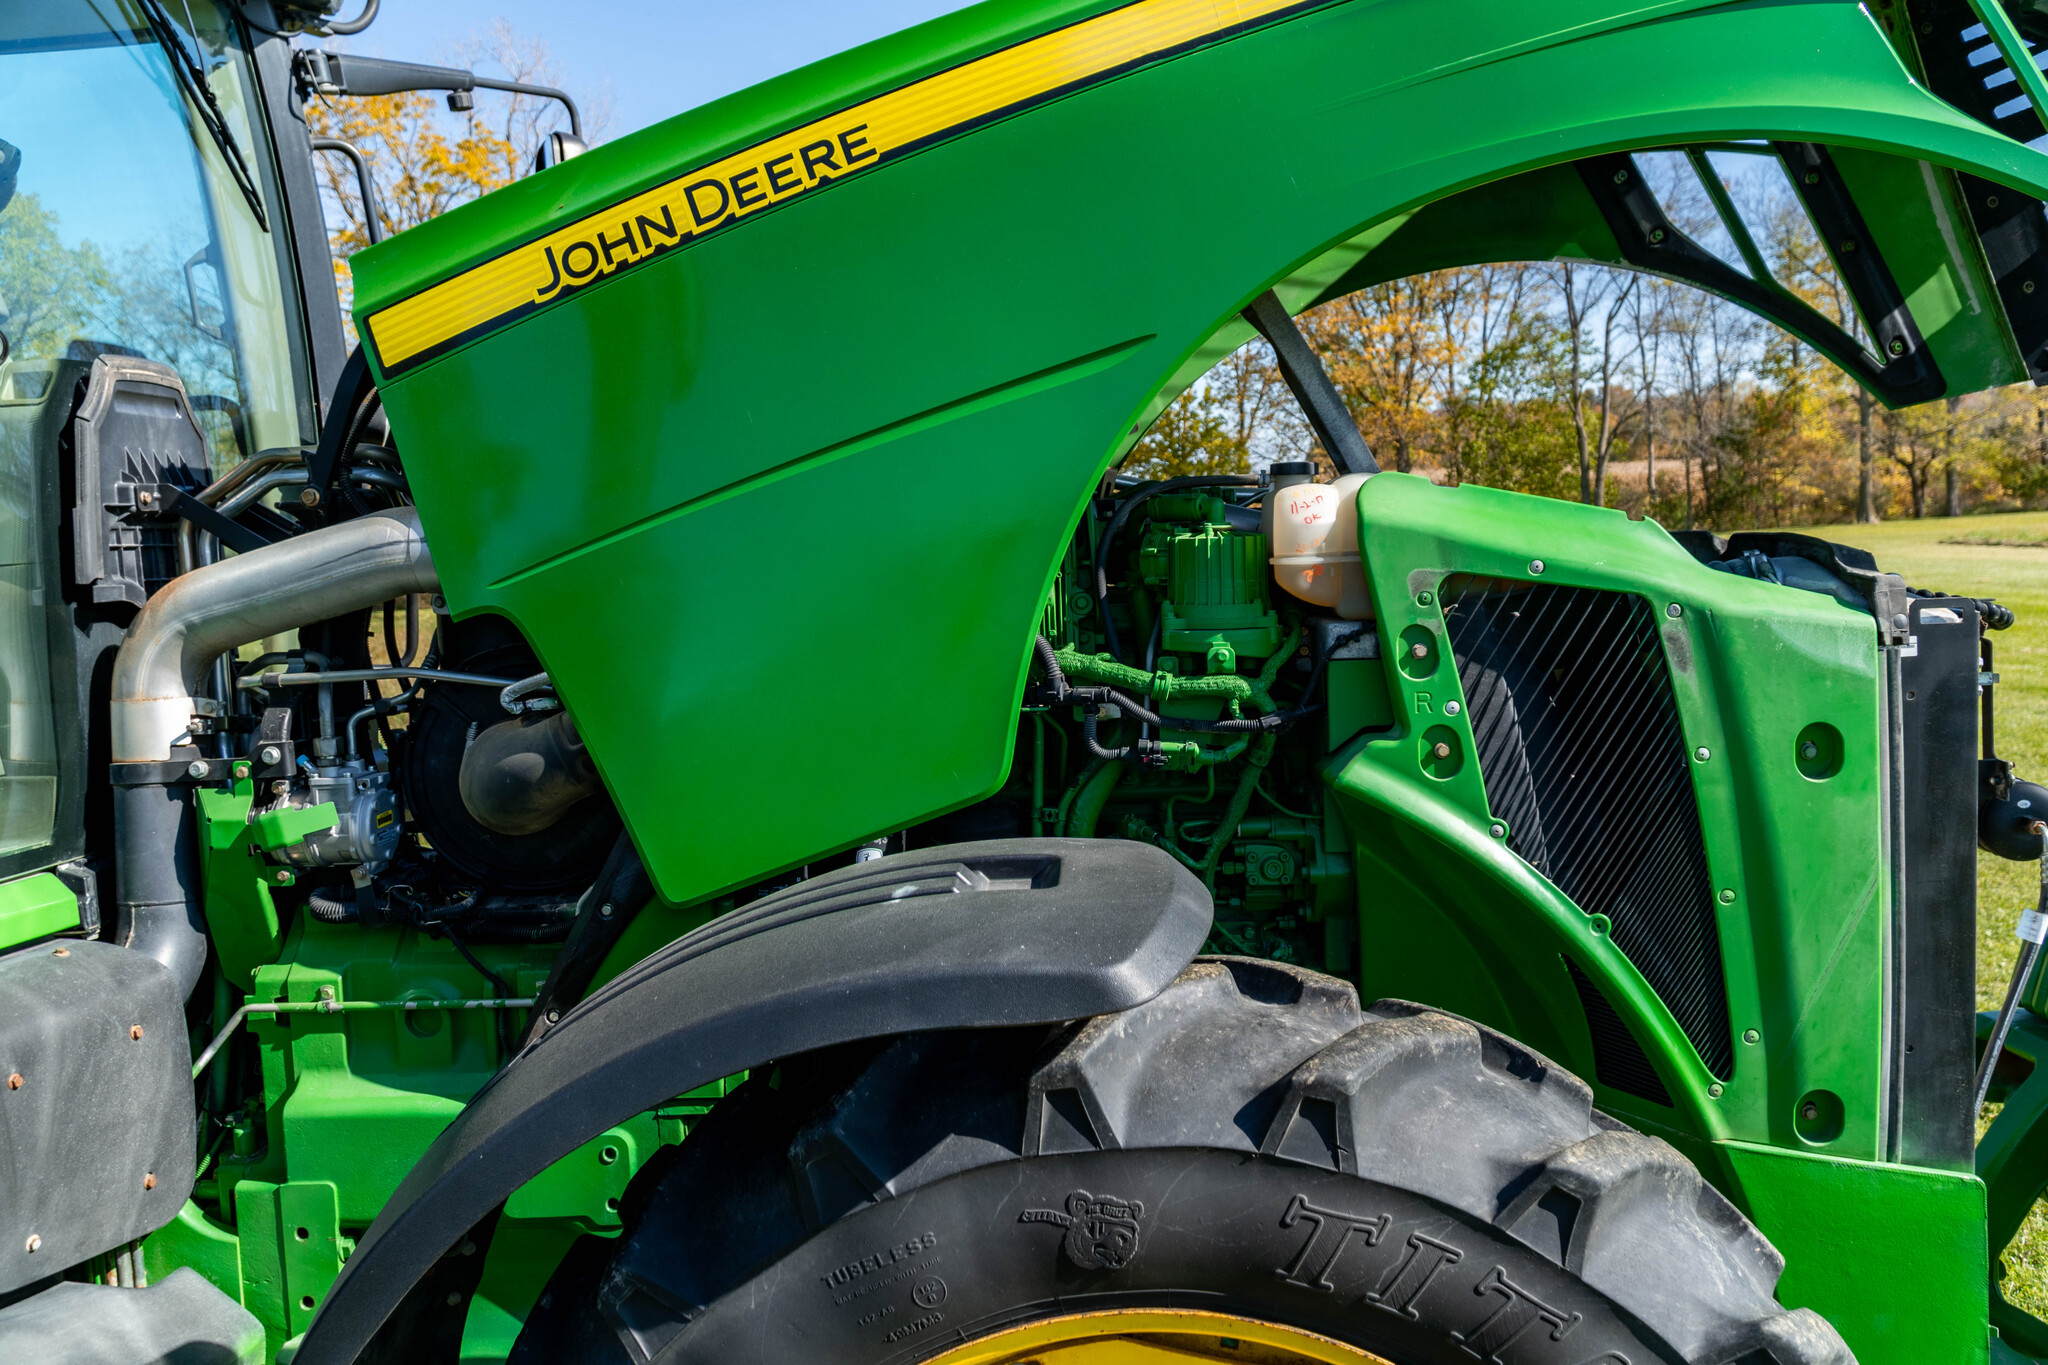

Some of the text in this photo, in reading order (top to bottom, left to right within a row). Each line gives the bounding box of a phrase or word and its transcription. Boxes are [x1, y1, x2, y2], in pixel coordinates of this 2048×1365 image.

[535, 122, 879, 297] JOHN DEERE
[1414, 691, 1433, 714] R
[822, 1231, 937, 1290] TUBELESS
[1275, 1193, 1632, 1365] TIT
